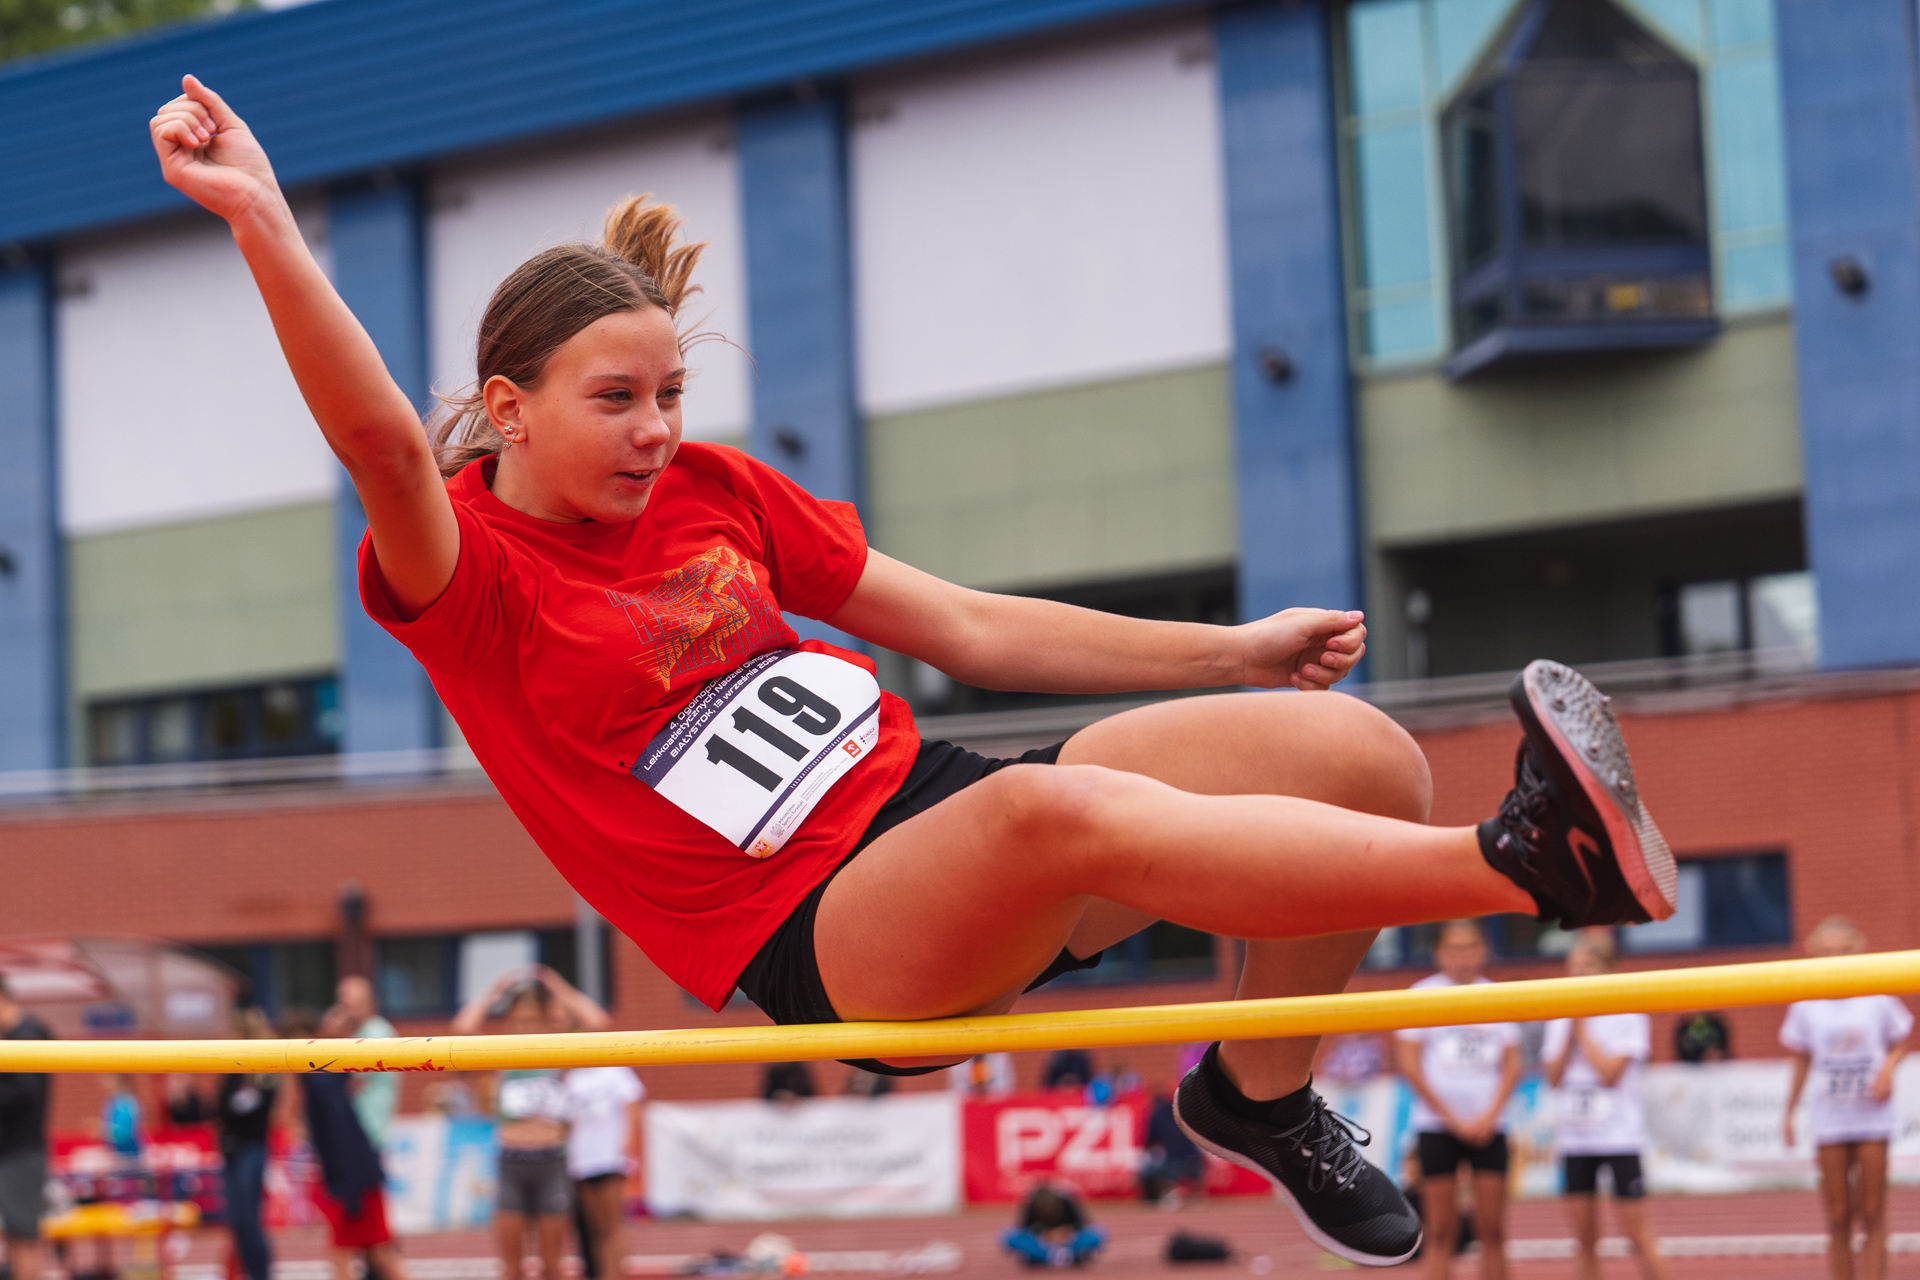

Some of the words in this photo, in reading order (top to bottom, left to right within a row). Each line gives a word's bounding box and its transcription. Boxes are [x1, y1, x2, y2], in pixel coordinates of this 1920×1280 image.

[644, 691, 717, 771] Lekkoatletycznych
[715, 666, 744, 693] Nadziei
[669, 721, 679, 730] 4.
[670, 707, 717, 758] BIAŁYSTOK,
[713, 698, 724, 708] 13
[722, 667, 759, 700] września
[757, 655, 779, 669] 2025
[704, 676, 841, 793] 119
